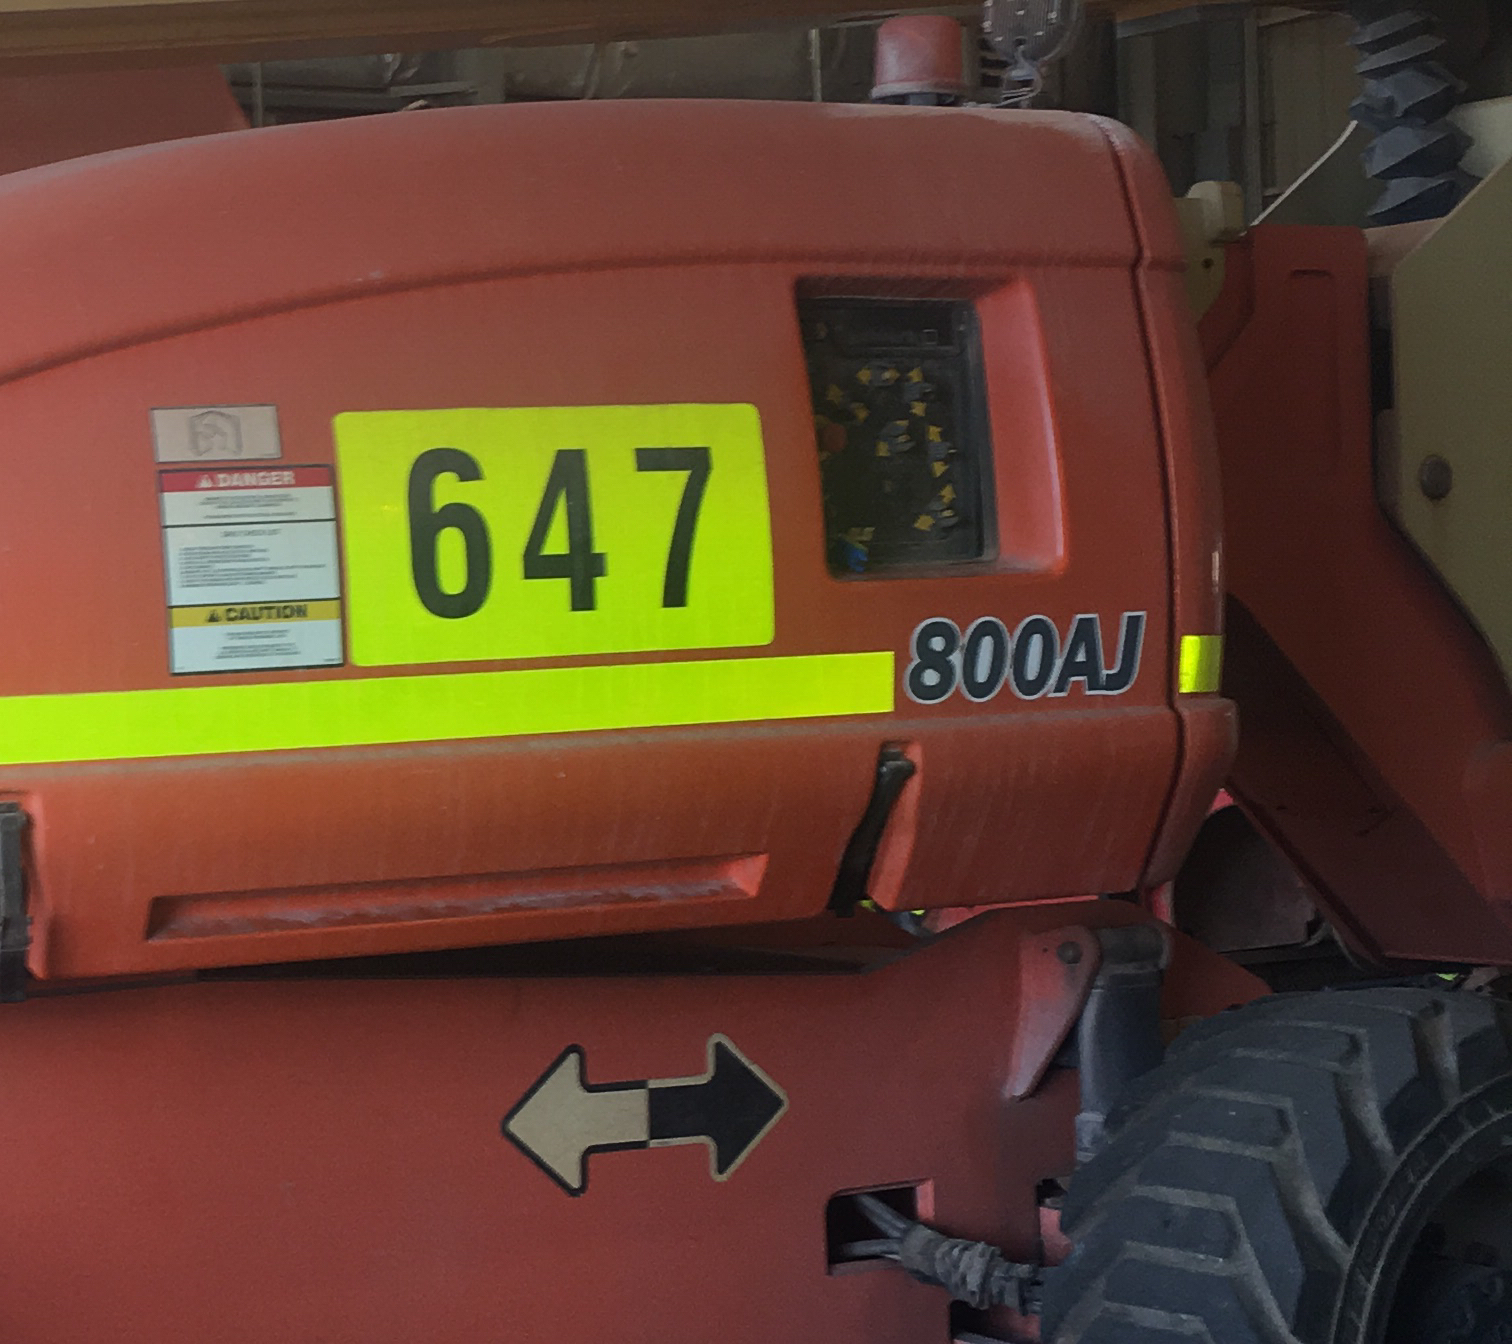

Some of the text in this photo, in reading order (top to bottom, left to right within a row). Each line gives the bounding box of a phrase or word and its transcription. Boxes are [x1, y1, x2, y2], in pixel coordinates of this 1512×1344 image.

[215, 470, 296, 488] DANGER
[407, 446, 714, 620] 647
[225, 603, 309, 622] CAUTION
[903, 611, 1148, 704] 800AJ
